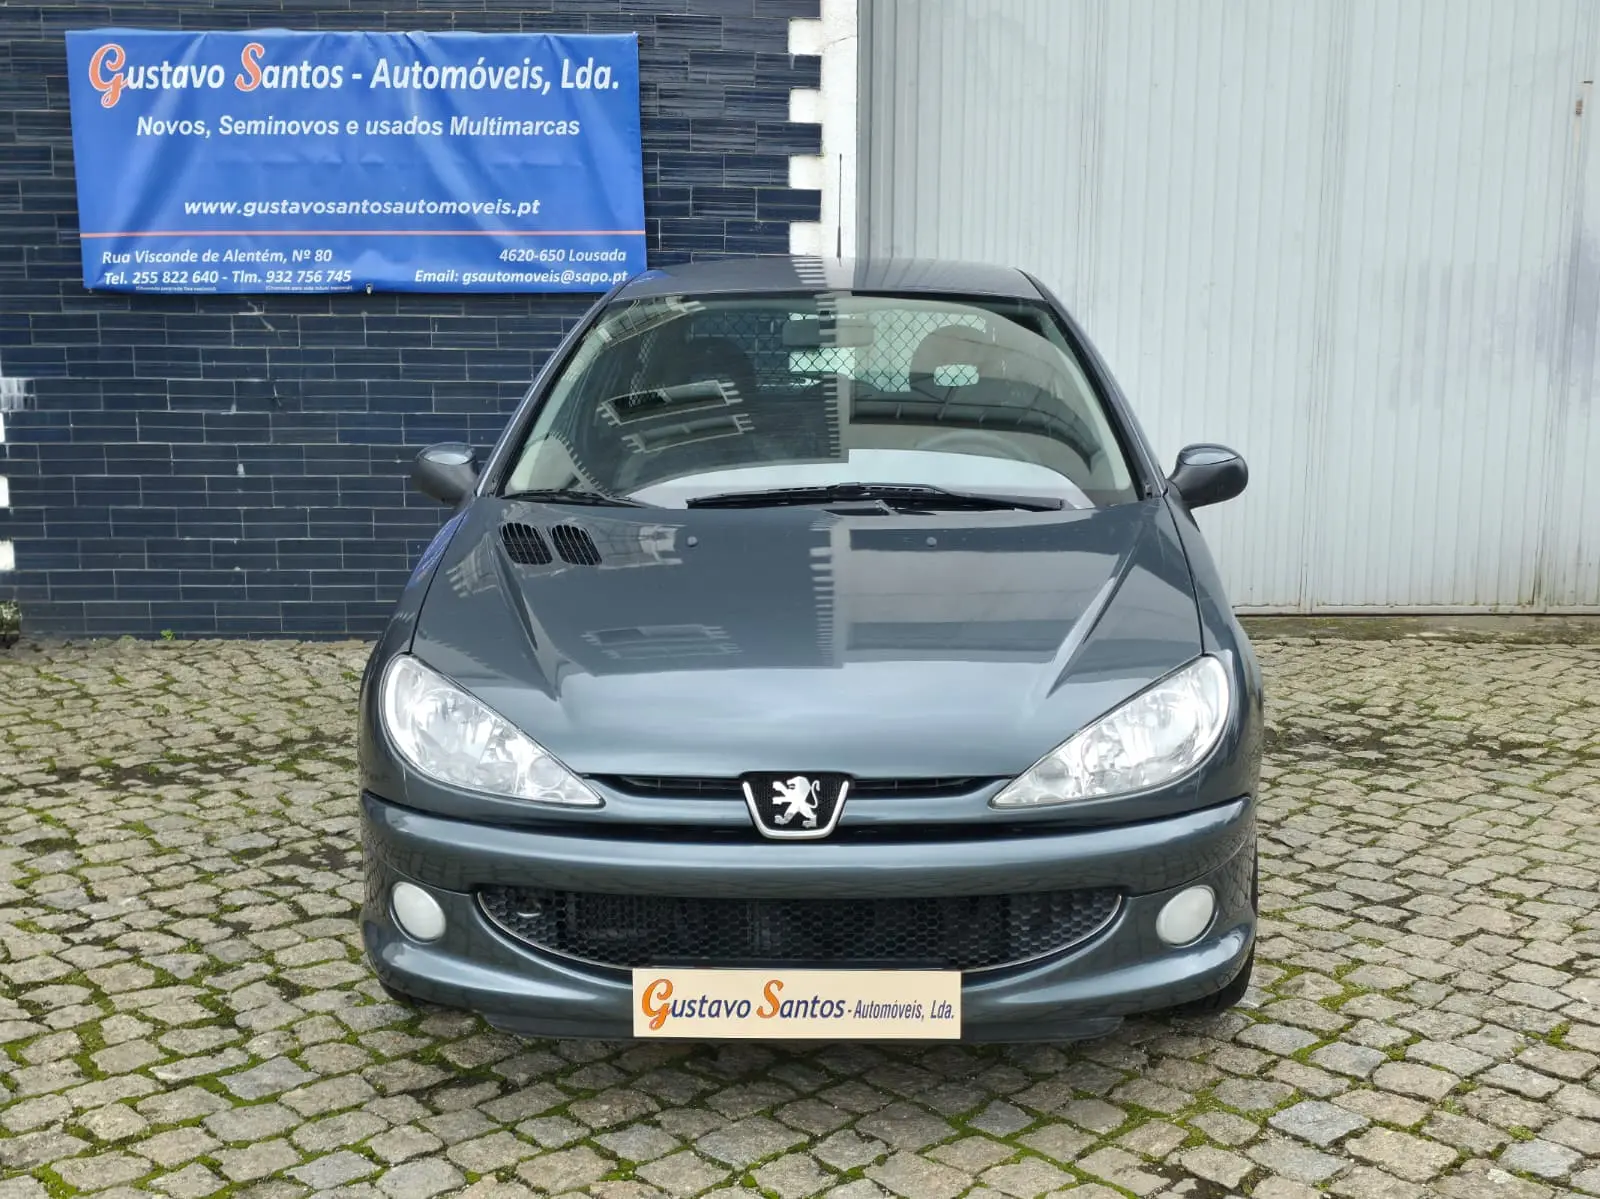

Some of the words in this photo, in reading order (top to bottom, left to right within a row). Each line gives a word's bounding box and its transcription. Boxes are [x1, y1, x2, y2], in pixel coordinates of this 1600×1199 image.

[88, 43, 225, 108] Gustavo
[234, 42, 343, 92] Santos
[370, 57, 551, 95] Automóveis,
[560, 57, 619, 89] Lda.
[136, 116, 211, 138] Novos,
[218, 115, 339, 136] Seminovos
[346, 121, 358, 135] e
[365, 117, 443, 136] usados
[450, 115, 580, 136] Multimarcas
[184, 199, 541, 218] www.gustavosantosautomoveis.pt
[102, 251, 131, 264] Rua
[135, 249, 198, 263] Visconde
[202, 248, 219, 262] de
[223, 248, 287, 264] Alentém,
[292, 249, 311, 262] Nº
[314, 249, 332, 262] 80
[499, 248, 565, 262] 4620-650
[568, 248, 627, 262] Lousada
[104, 272, 128, 285] Tel.
[132, 271, 158, 284] 255
[162, 271, 188, 283] 822
[192, 270, 219, 283] 640
[231, 270, 261, 283] Tlm.
[265, 270, 292, 283] 932
[297, 270, 322, 283] 756
[326, 270, 352, 282] 745
[414, 270, 458, 283] Email:
[462, 270, 628, 285] gsautomoveis@sapo.pt
[642, 978, 750, 1031] Gustavo
[756, 979, 846, 1019] Santos
[853, 1000, 925, 1021] Automóveis,
[930, 1000, 954, 1020] Lda.
